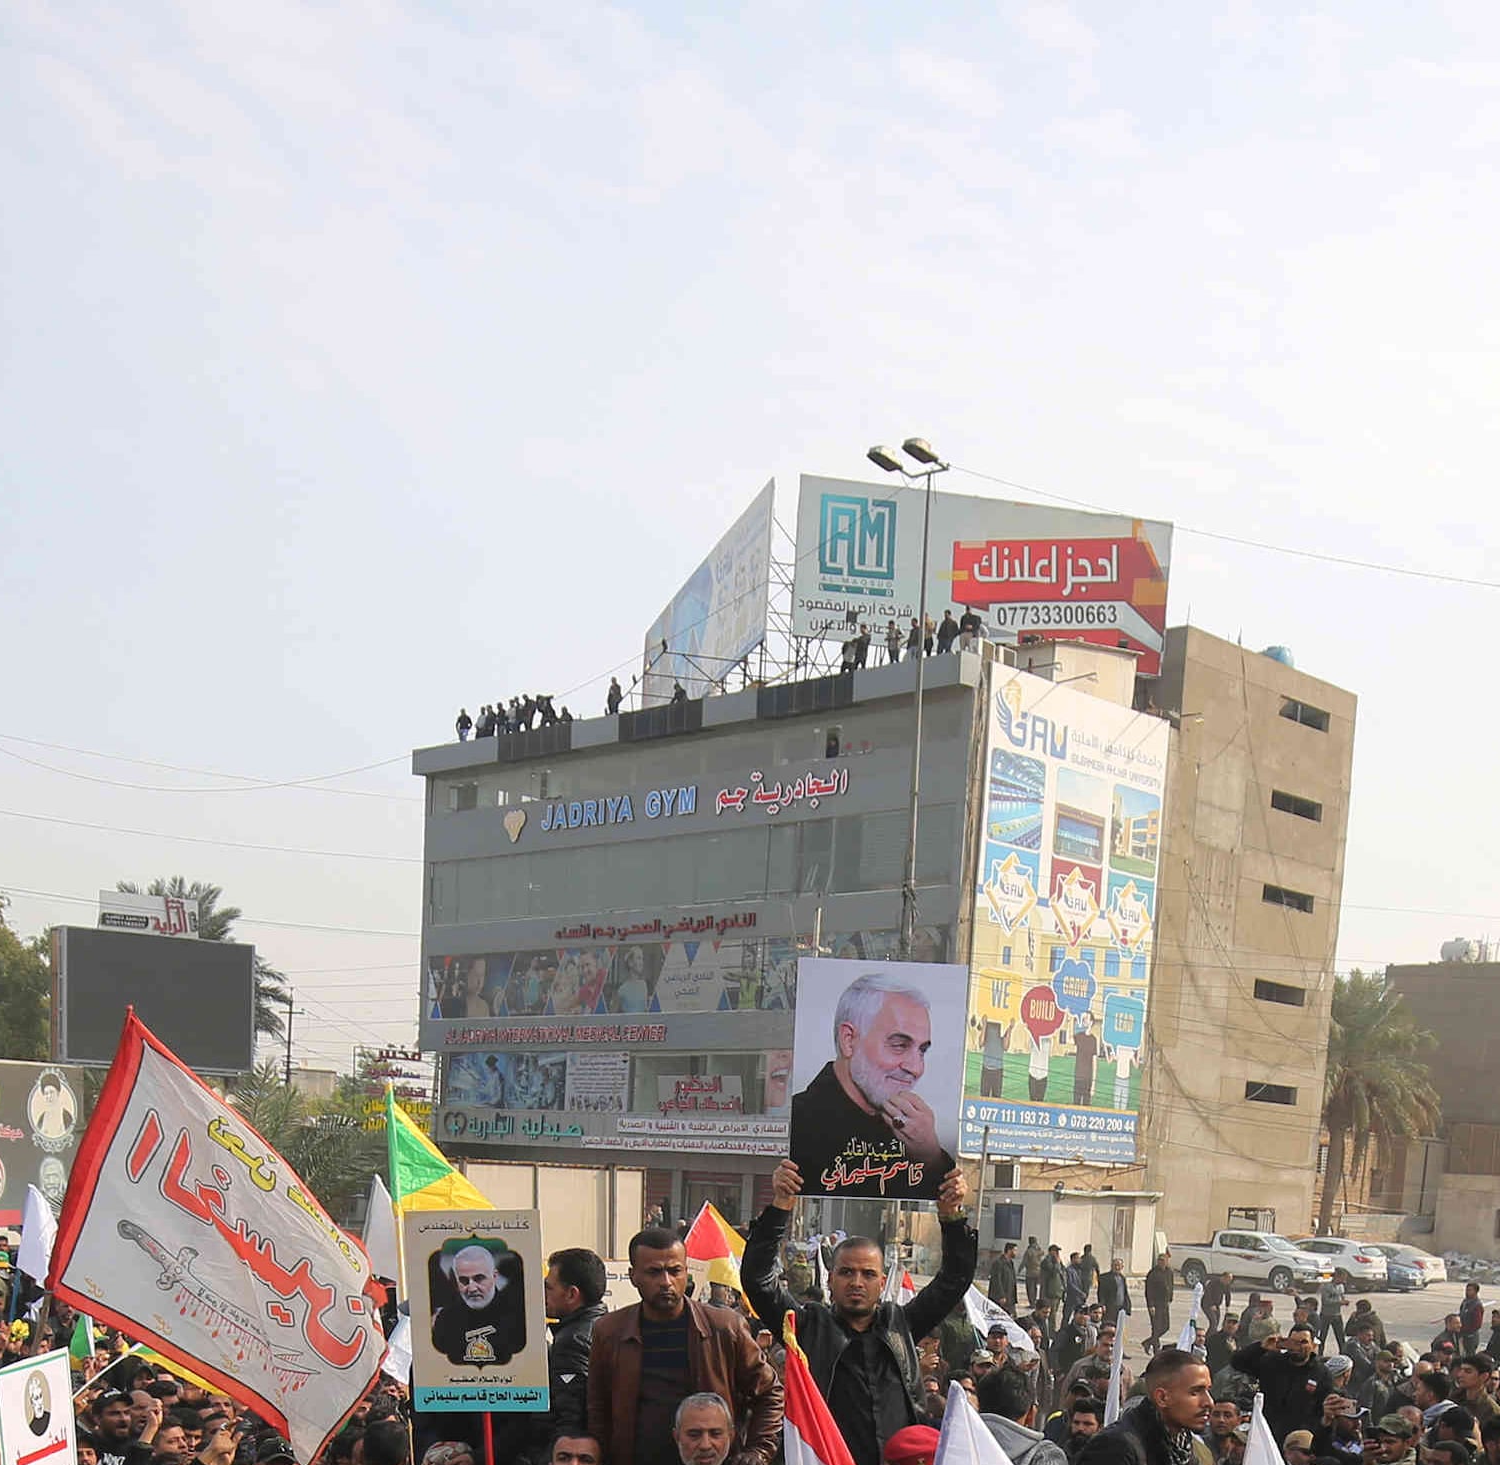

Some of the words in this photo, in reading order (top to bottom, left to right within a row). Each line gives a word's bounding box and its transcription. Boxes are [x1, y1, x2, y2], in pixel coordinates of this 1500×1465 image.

[972, 544, 1059, 584] اعلانك
[1062, 544, 1119, 597] احجز
[798, 599, 850, 613] المقصود
[878, 605, 913, 618] شركة
[997, 604, 1118, 626] 07733300663
[751, 768, 850, 815] الجادرية
[541, 795, 635, 832] JADRIYA
[645, 786, 697, 818] GYM
[991, 980, 1011, 1010] WE
[1029, 999, 1056, 1020] BUILD
[979, 1107, 999, 1120] 077
[1000, 1109, 1017, 1122] 111
[1019, 1110, 1037, 1124] 193
[1038, 1111, 1051, 1126] 73
[521, 1114, 585, 1141] صيدلية
[423, 1390, 460, 1405] سليماني
[461, 1389, 487, 1404] قاسم
[488, 1390, 511, 1404] الحاج
[513, 1389, 542, 1404] الشهيد
